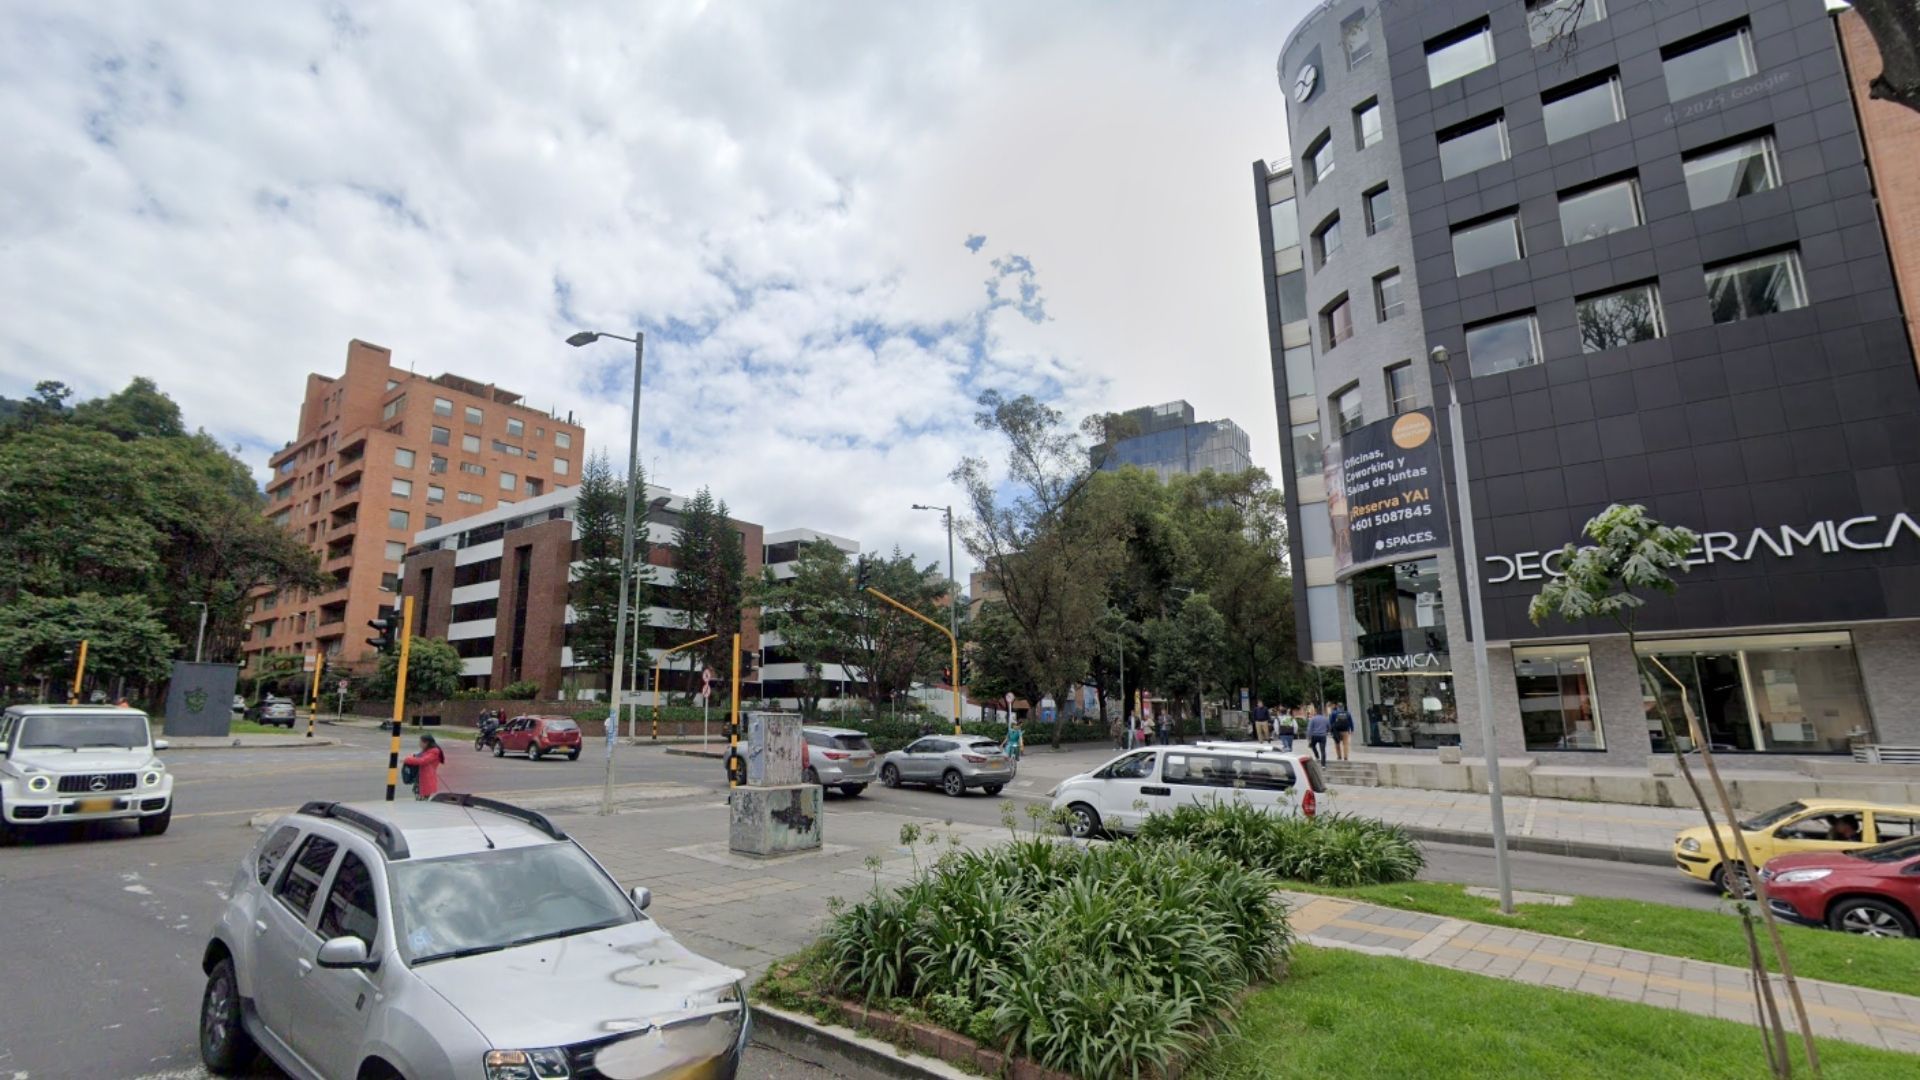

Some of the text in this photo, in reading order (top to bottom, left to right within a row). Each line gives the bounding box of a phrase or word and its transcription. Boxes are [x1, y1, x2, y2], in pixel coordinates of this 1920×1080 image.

[1344, 449, 1384, 469] Oficinas,
[1346, 460, 1394, 482] Coworking
[1347, 467, 1428, 496] Salas de juntas
[1402, 487, 1429, 504] YA!
[1350, 504, 1432, 531] +601 5087845
[1484, 512, 1920, 583] DECERAMICA
